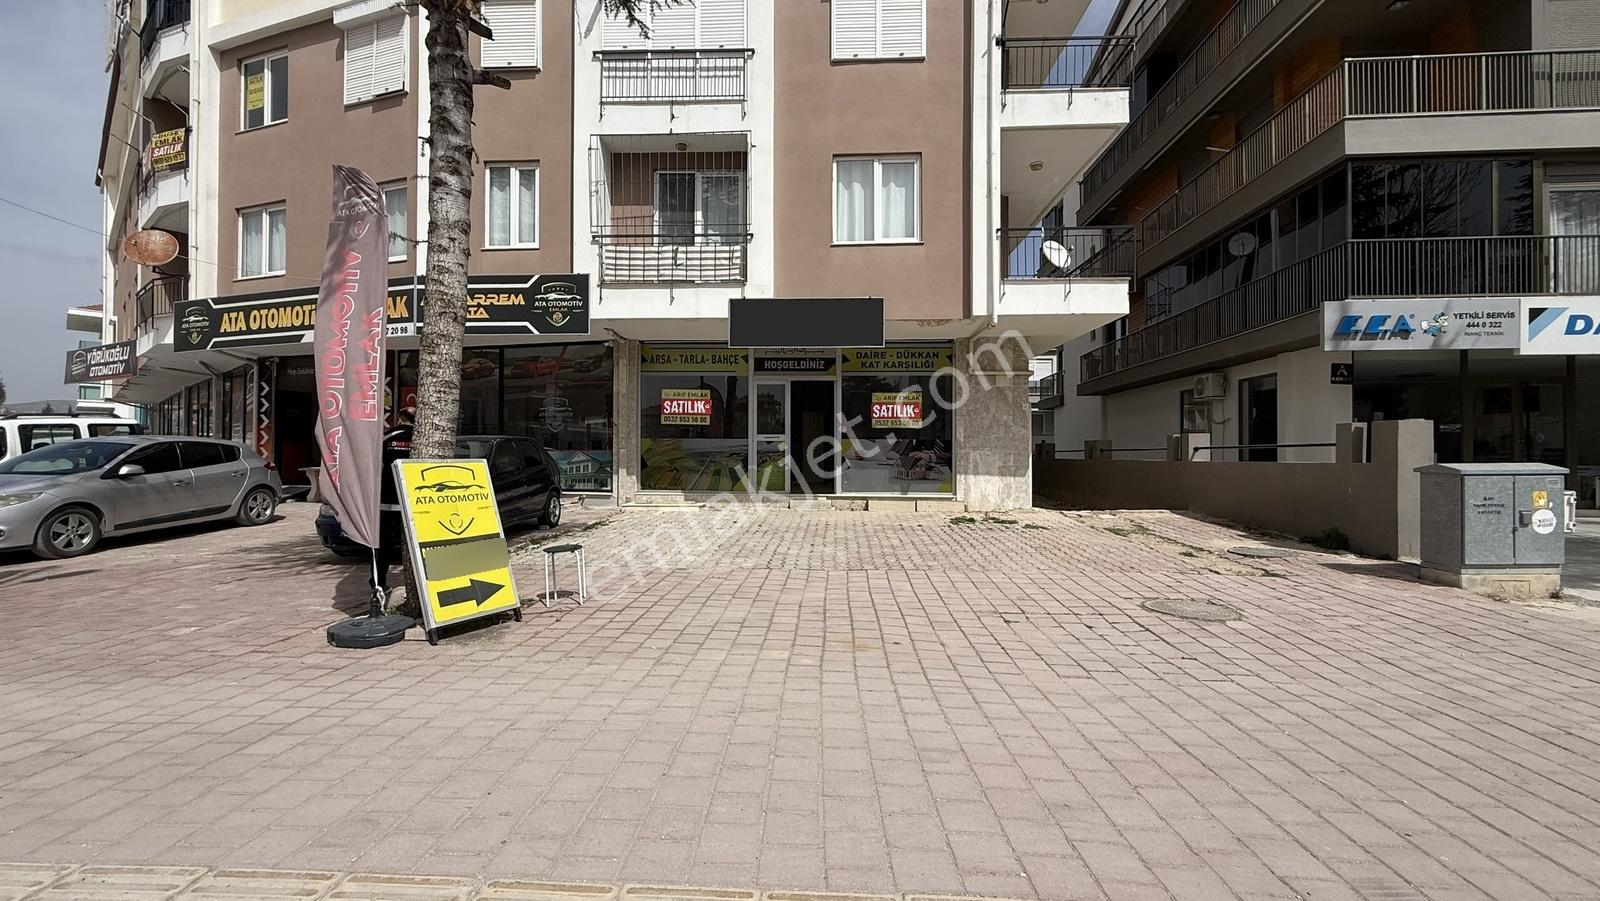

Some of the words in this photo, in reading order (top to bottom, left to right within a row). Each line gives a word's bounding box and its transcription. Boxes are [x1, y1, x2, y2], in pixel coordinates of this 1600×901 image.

[220, 311, 247, 332] ATA
[249, 304, 316, 330] OTOMOTİ
[1453, 311, 1484, 320] YETKİLİ
[1486, 310, 1516, 319] SERVİS
[390, 326, 398, 335] 20
[400, 326, 408, 334] 98
[86, 344, 130, 365] YÖRÜKOĞLU
[649, 354, 672, 365] ARSA
[711, 354, 739, 366] BAHÇE
[856, 349, 887, 359] DAİRE
[896, 349, 939, 359] DÜKKAN
[89, 361, 126, 377] OTOMOTİV
[347, 307, 383, 421] EMLAK
[764, 358, 825, 371] HOŞGELDİNİZ
[861, 361, 881, 369] KAT
[884, 359, 934, 371] KARŞILIĞI
[664, 400, 706, 414] SATILIK
[872, 404, 915, 418] SATILIK
[415, 496, 436, 505] ATA
[437, 491, 489, 504] OTOMOTİV
